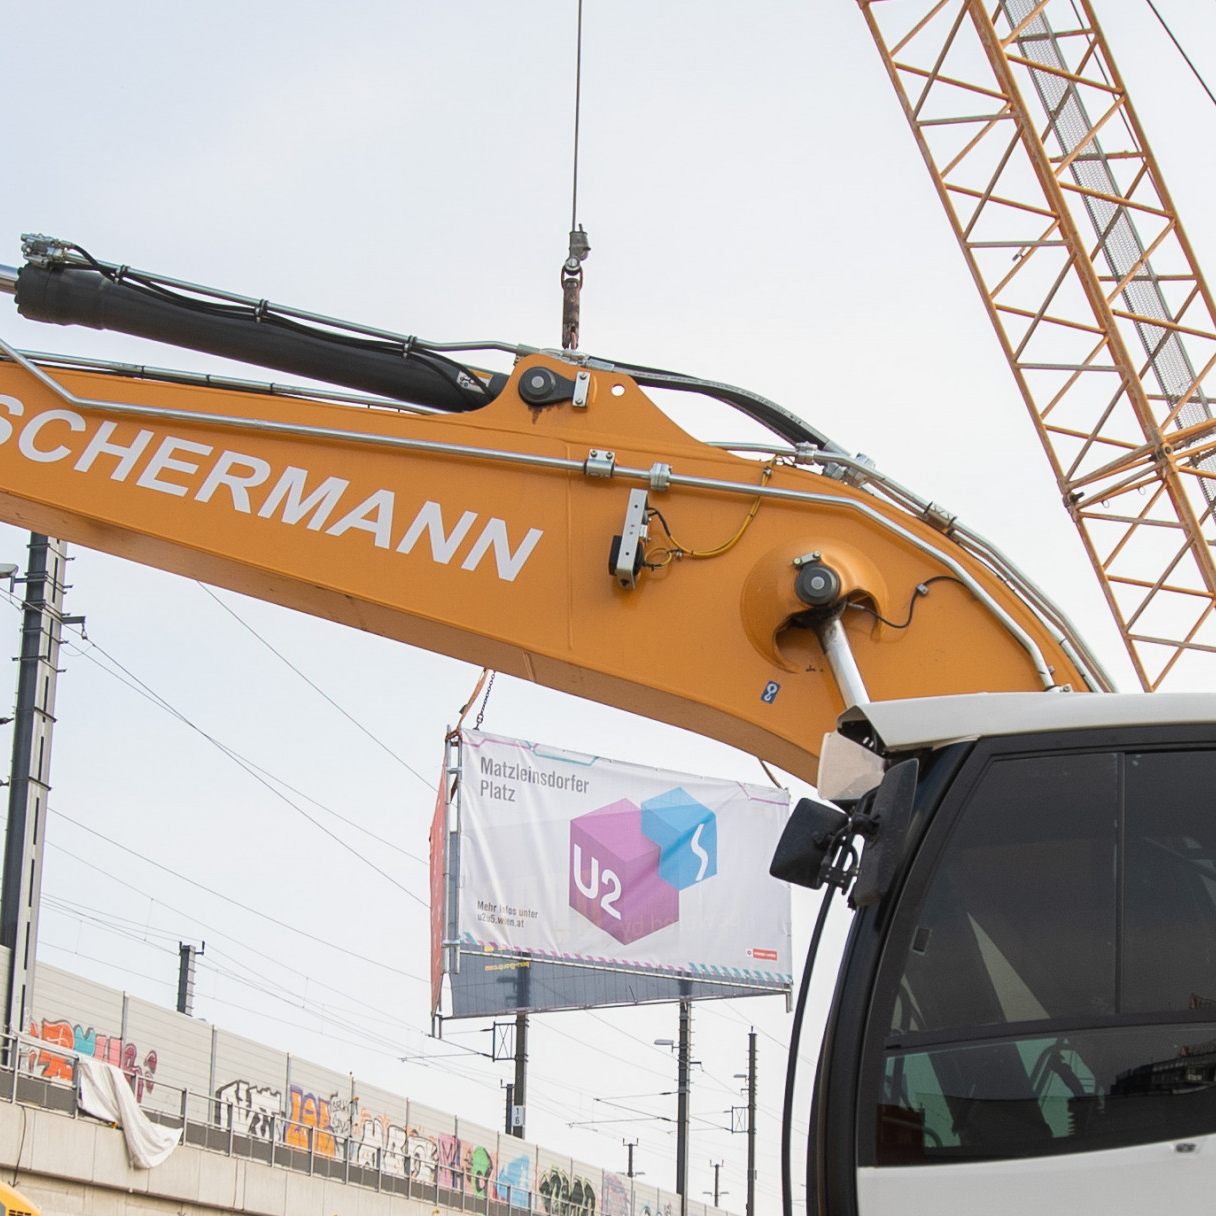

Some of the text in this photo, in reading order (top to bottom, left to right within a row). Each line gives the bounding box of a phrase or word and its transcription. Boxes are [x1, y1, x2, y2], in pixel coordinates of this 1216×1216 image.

[480, 756, 590, 794] Matzleinsdorfer
[480, 779, 516, 802] Platz
[573, 843, 622, 920] U2
[477, 900, 497, 912] Mehr
[519, 907, 538, 918] unter
